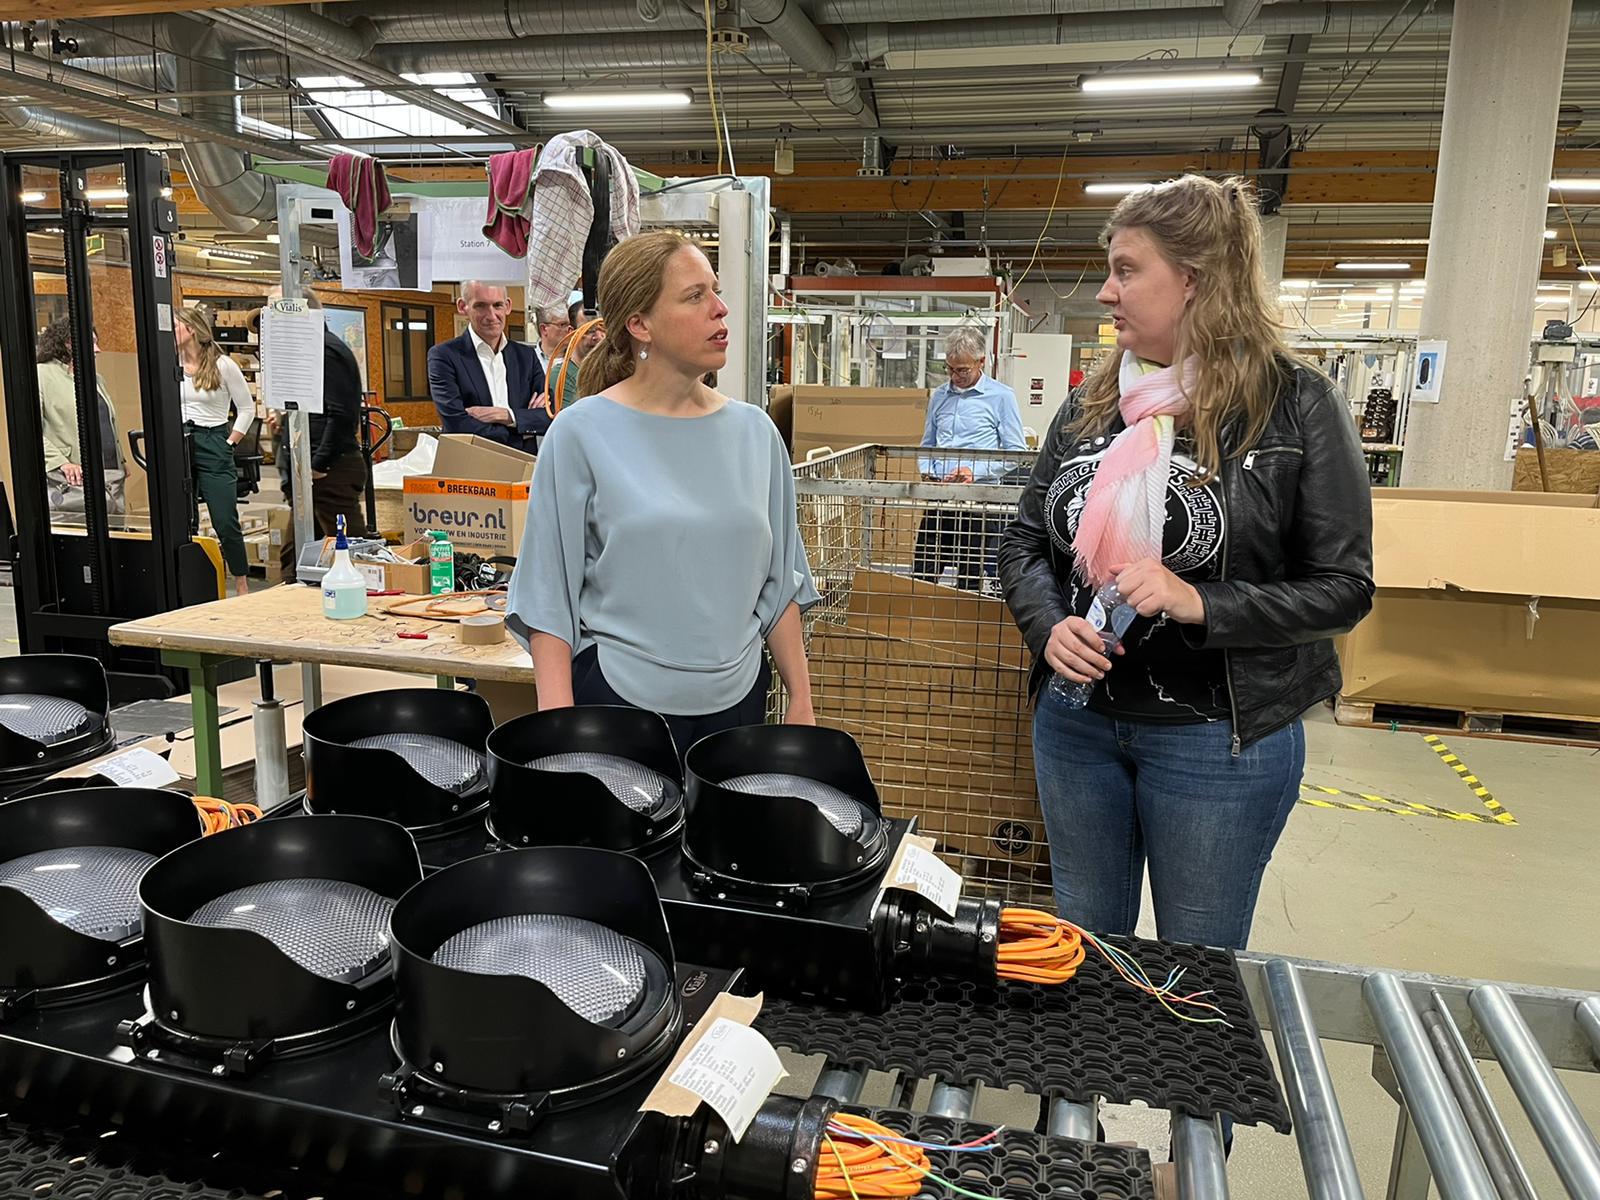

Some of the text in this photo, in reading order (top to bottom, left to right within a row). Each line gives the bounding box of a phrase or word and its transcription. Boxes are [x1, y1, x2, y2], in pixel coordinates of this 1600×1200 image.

[460, 240, 485, 248] Station
[280, 302, 303, 313] Vialis
[447, 484, 496, 497] BREEKBAAR
[467, 531, 506, 541] INDUSTRIE
[684, 970, 708, 992] Vialis
